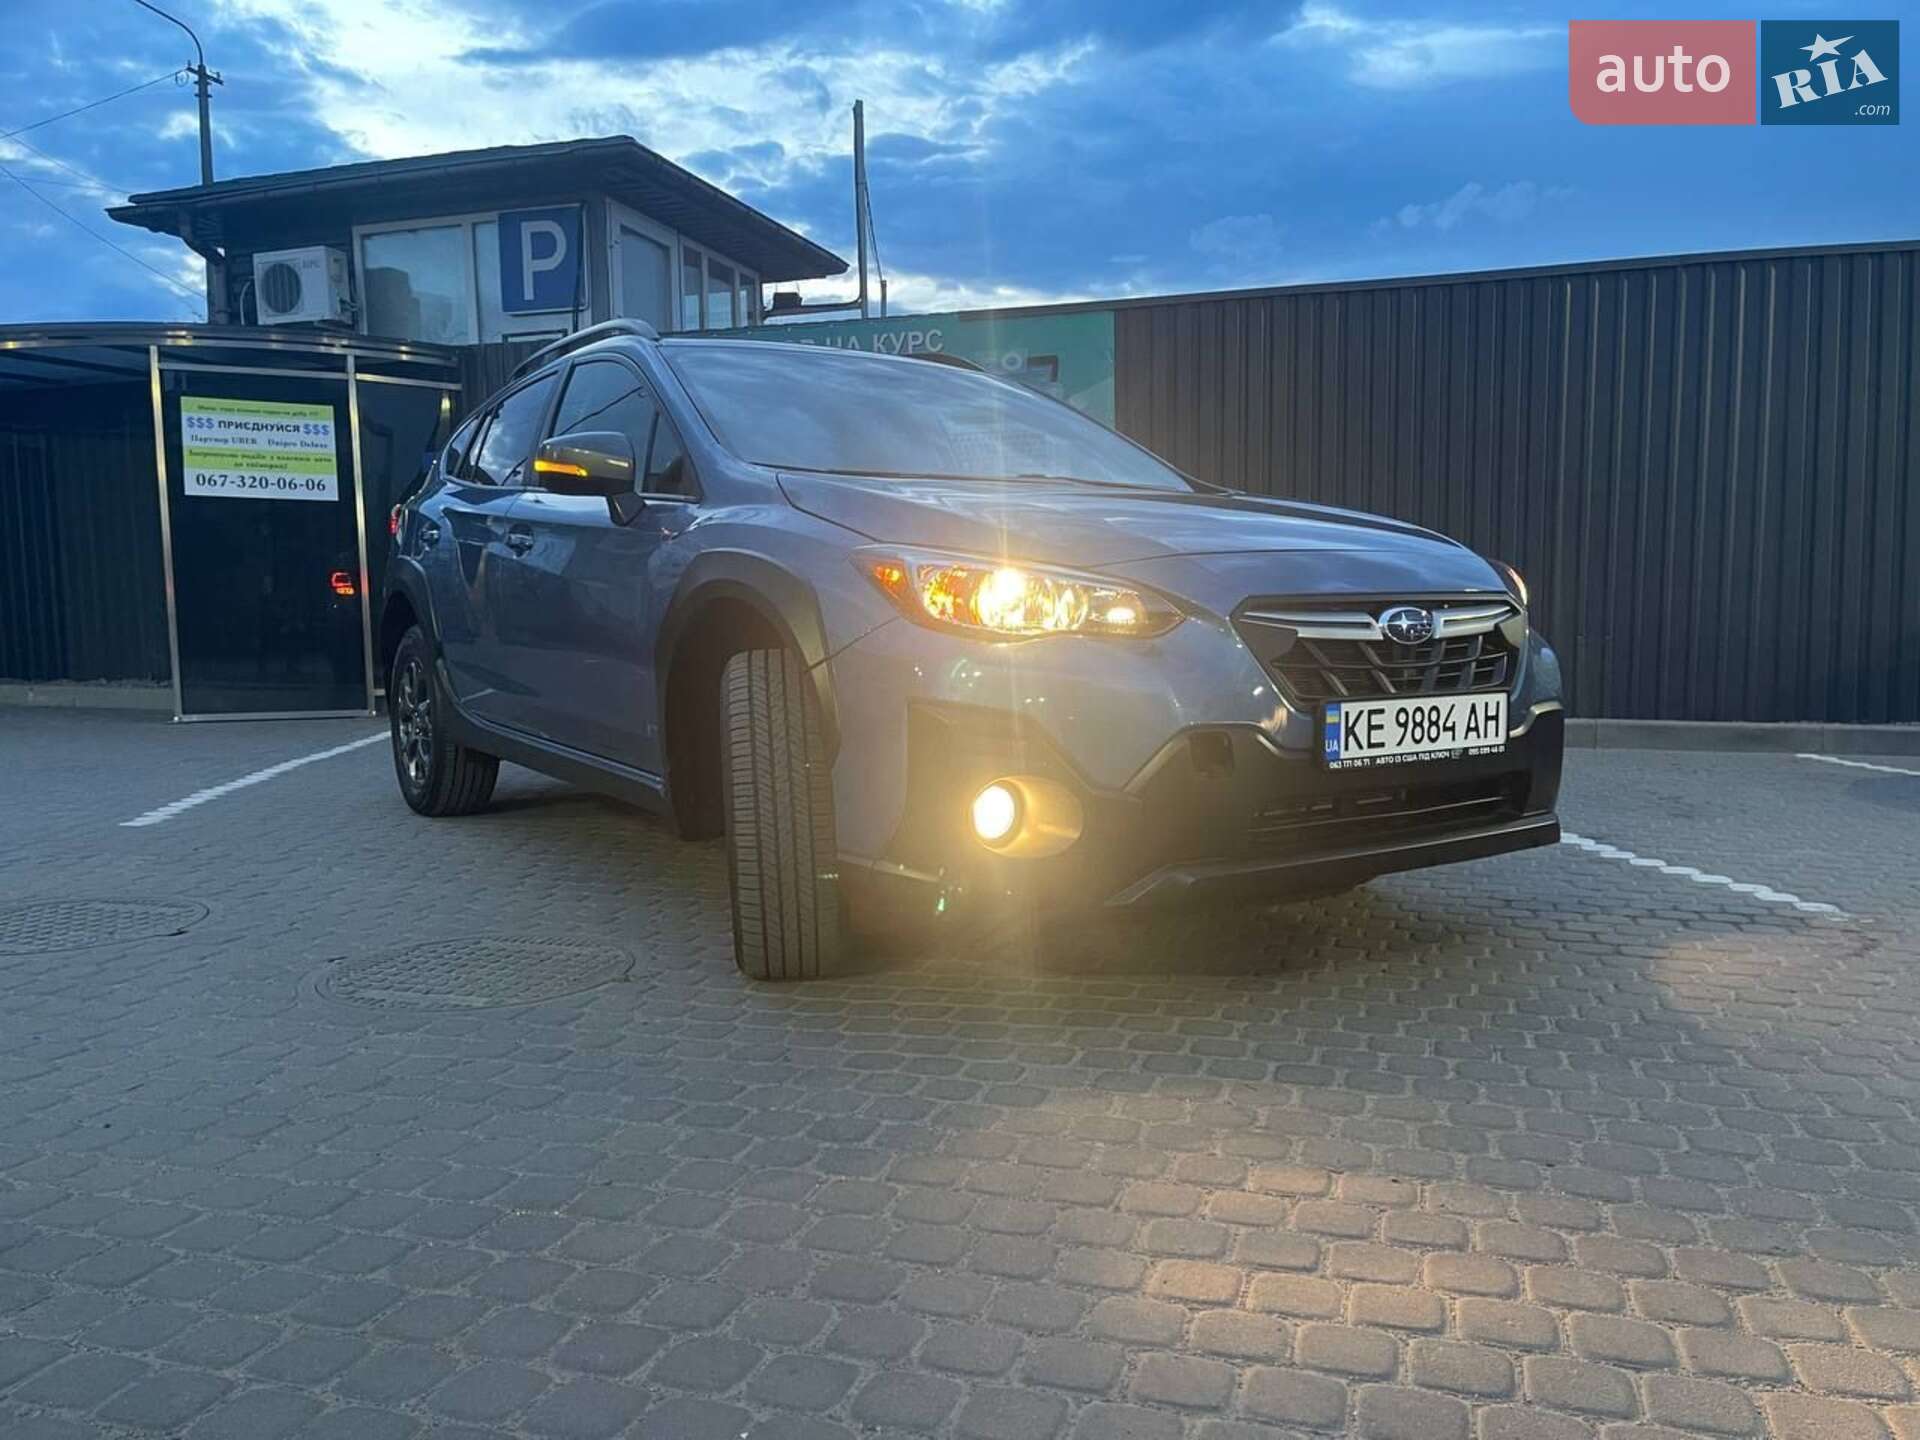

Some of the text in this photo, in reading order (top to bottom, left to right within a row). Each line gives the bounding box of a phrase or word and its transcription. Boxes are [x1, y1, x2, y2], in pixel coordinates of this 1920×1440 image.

[520, 219, 567, 301] P
[872, 329, 944, 354] КУРС
[195, 473, 326, 492] 067-320-06-06
[1343, 700, 1501, 752] KE 9884 AH
[1325, 740, 1339, 753] UA
[1376, 755, 1394, 764] АВТО
